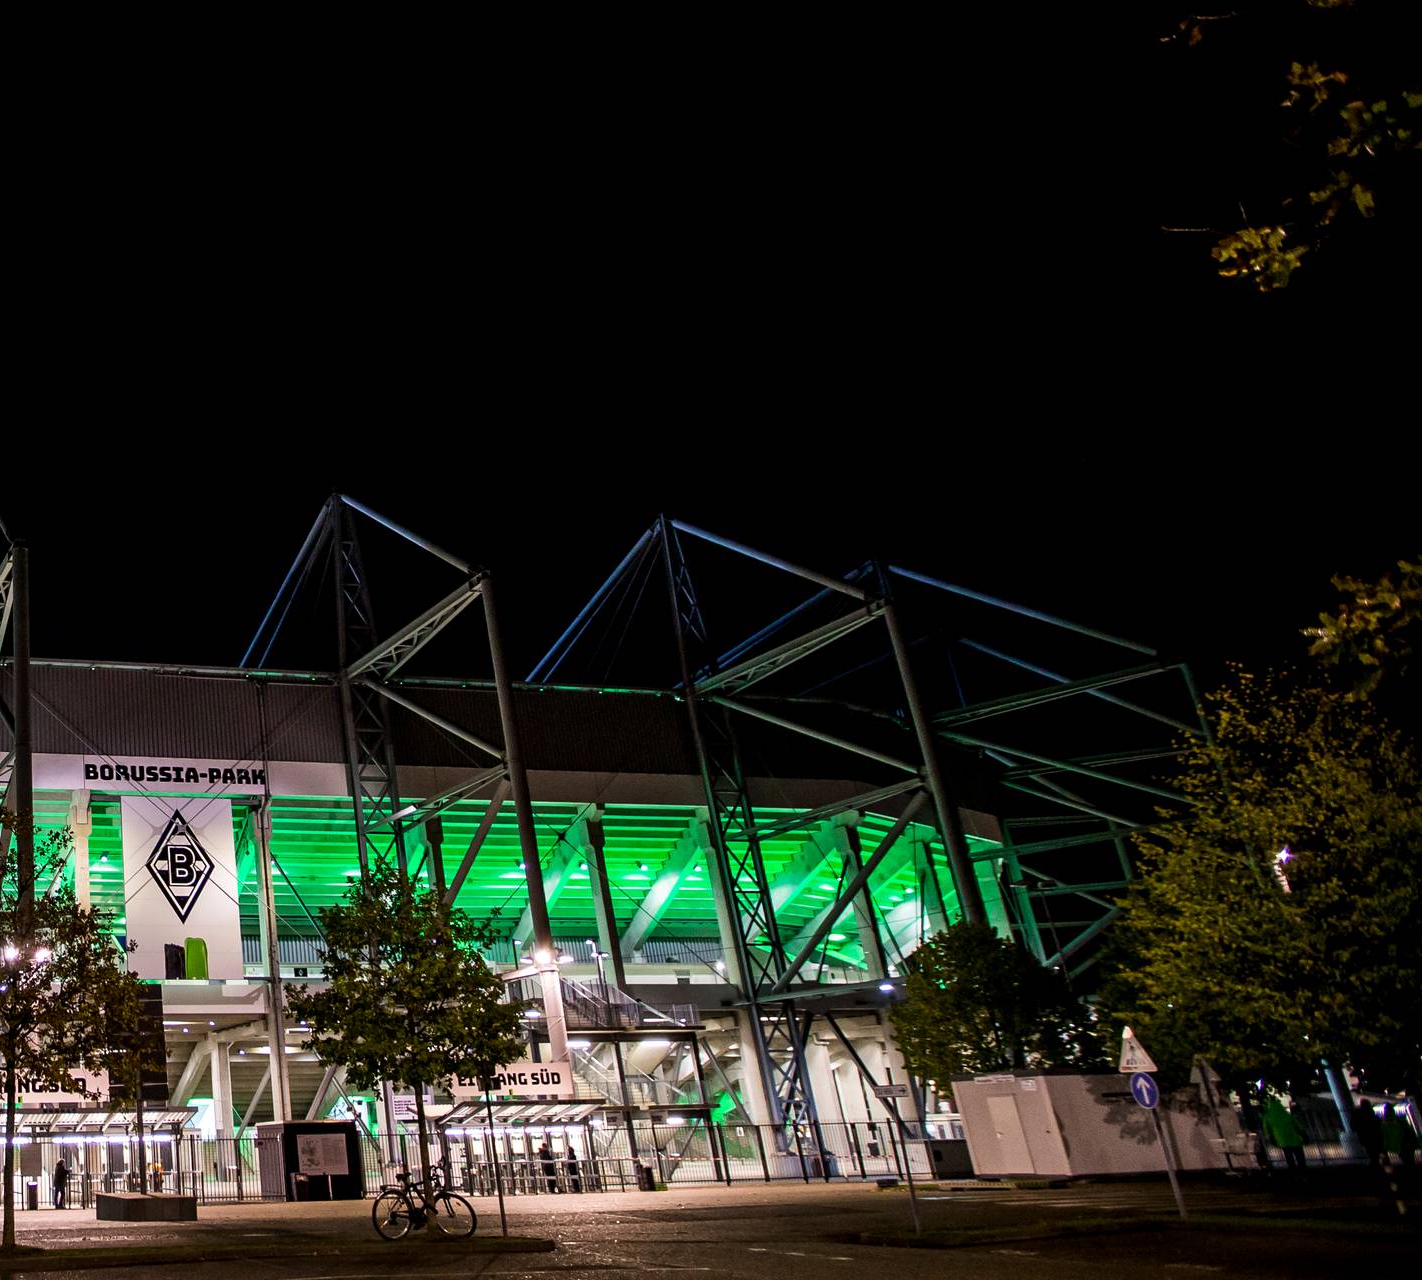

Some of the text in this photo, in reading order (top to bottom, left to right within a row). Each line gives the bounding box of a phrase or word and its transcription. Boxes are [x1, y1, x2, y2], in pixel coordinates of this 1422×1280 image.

[85, 764, 265, 785] BORUSSIA-PARK
[168, 845, 196, 885] B
[530, 1068, 561, 1086] SÜD
